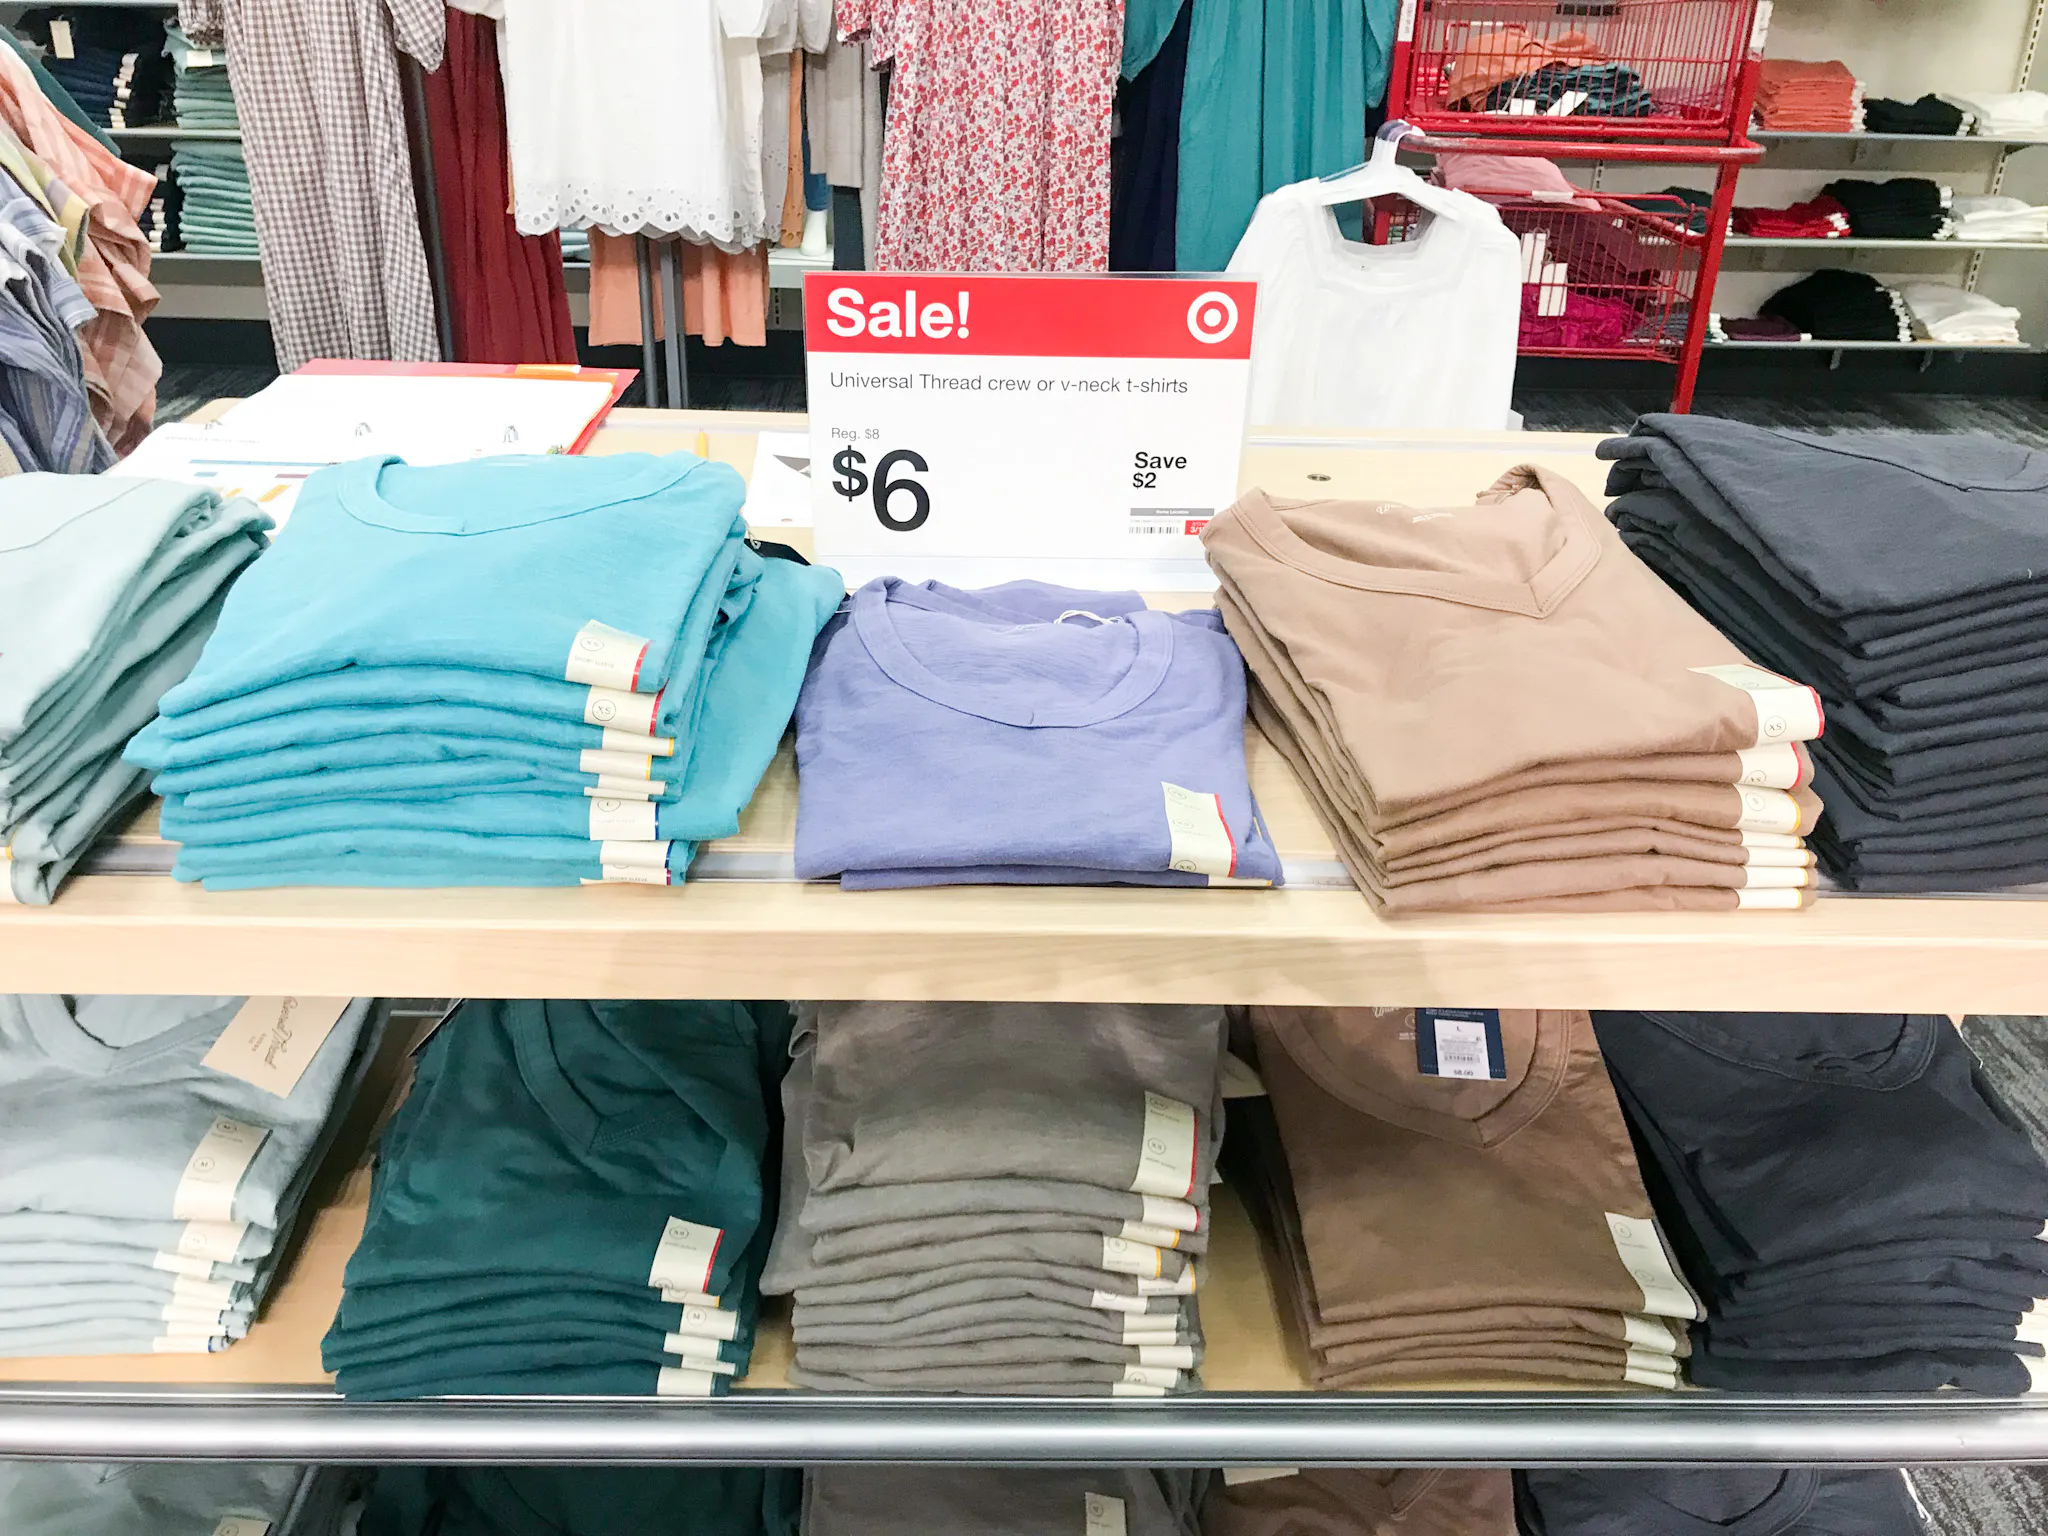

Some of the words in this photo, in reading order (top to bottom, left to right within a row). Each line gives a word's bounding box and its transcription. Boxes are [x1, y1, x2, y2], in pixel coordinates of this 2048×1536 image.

[826, 287, 970, 339] Sale!
[830, 372, 913, 389] Universal
[919, 374, 982, 390] Thread
[988, 378, 1031, 391] crew
[1037, 379, 1055, 391] or
[1061, 377, 1121, 392] v-neck
[1127, 378, 1188, 393] t-shirts
[831, 427, 861, 442] Reg.
[864, 428, 880, 440] $8
[1134, 451, 1188, 469] Save
[832, 445, 930, 532] $6
[1132, 472, 1157, 490] $2
